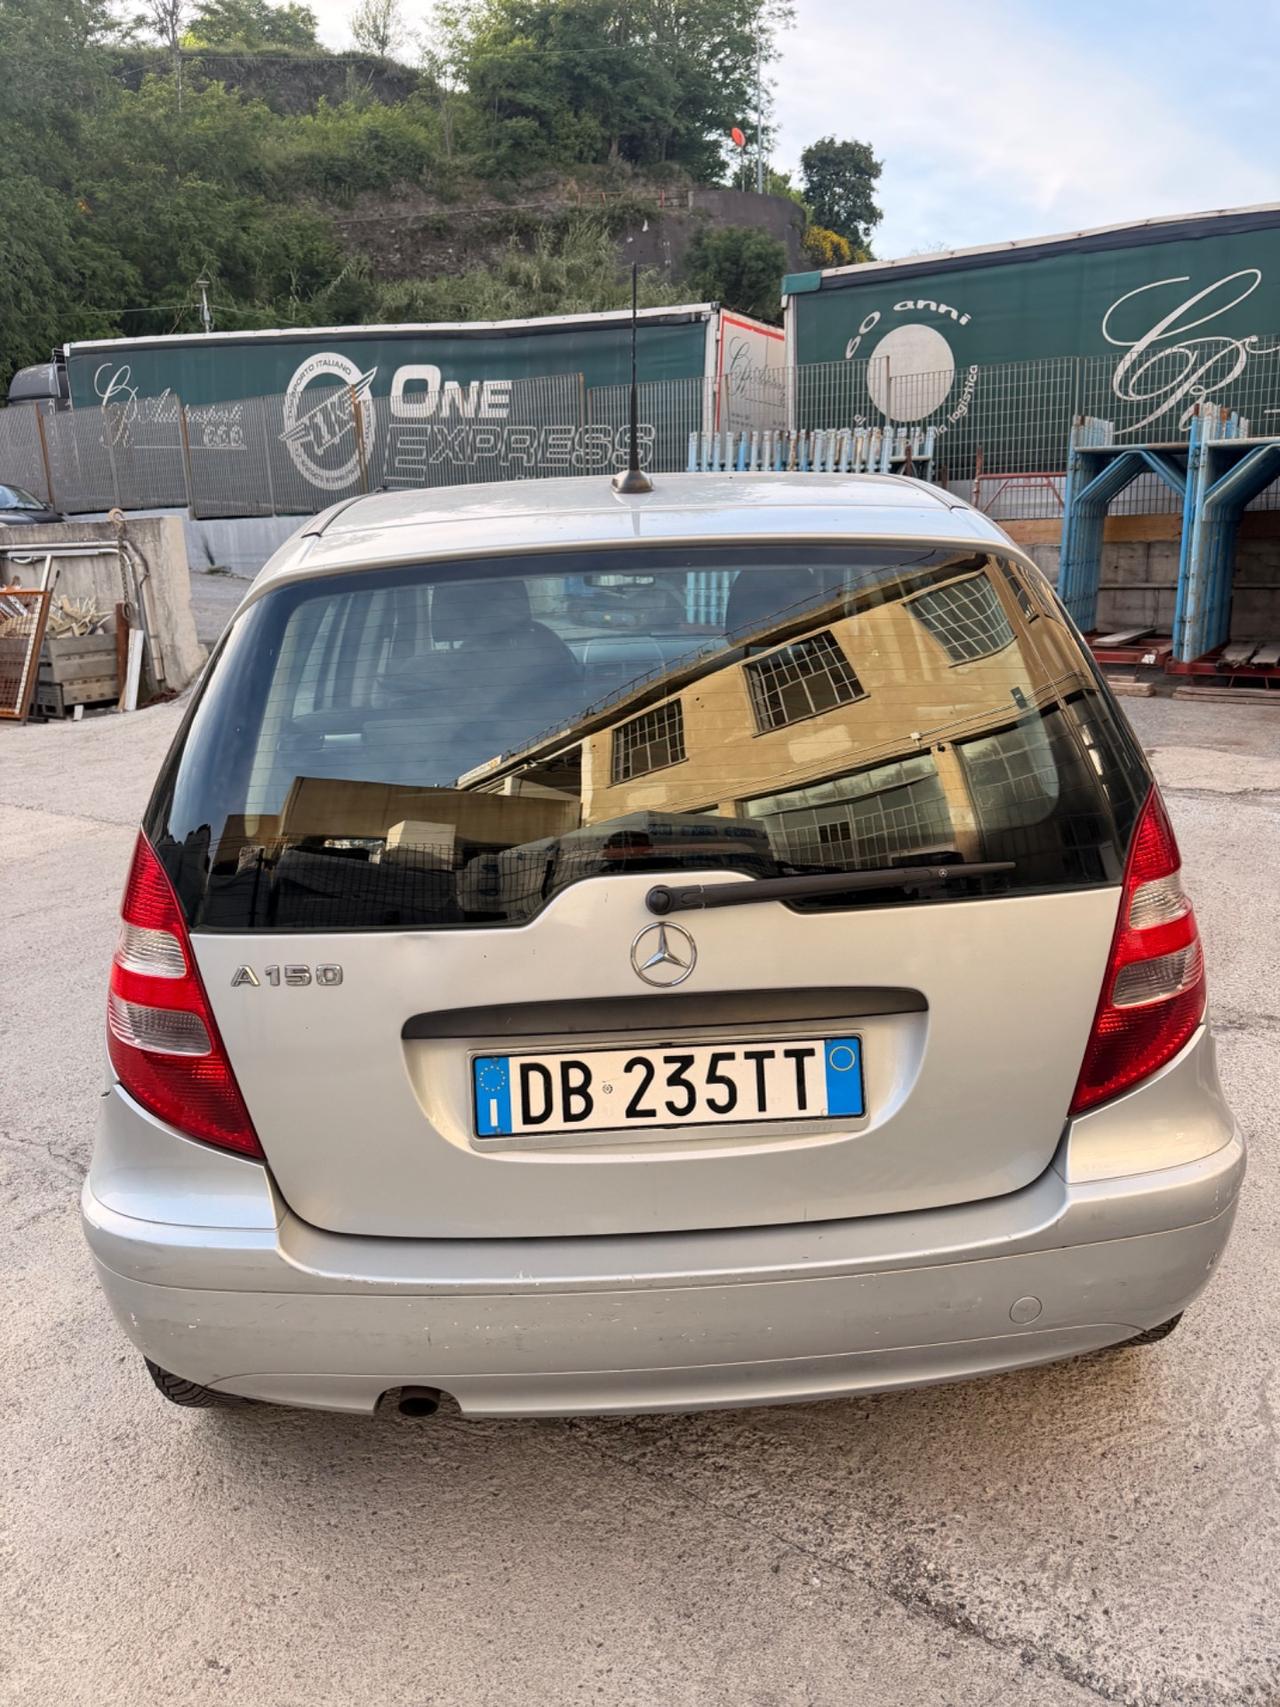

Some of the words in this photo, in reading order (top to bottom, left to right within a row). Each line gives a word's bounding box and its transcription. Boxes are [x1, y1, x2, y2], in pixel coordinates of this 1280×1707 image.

[893, 299, 972, 326] anni
[315, 359, 353, 377] ITALIANO
[390, 363, 513, 419] ONE
[947, 364, 979, 424] logistica
[384, 423, 656, 482] EXPRESS
[519, 1059, 594, 1126] DB
[623, 1047, 816, 1119] 235TT
